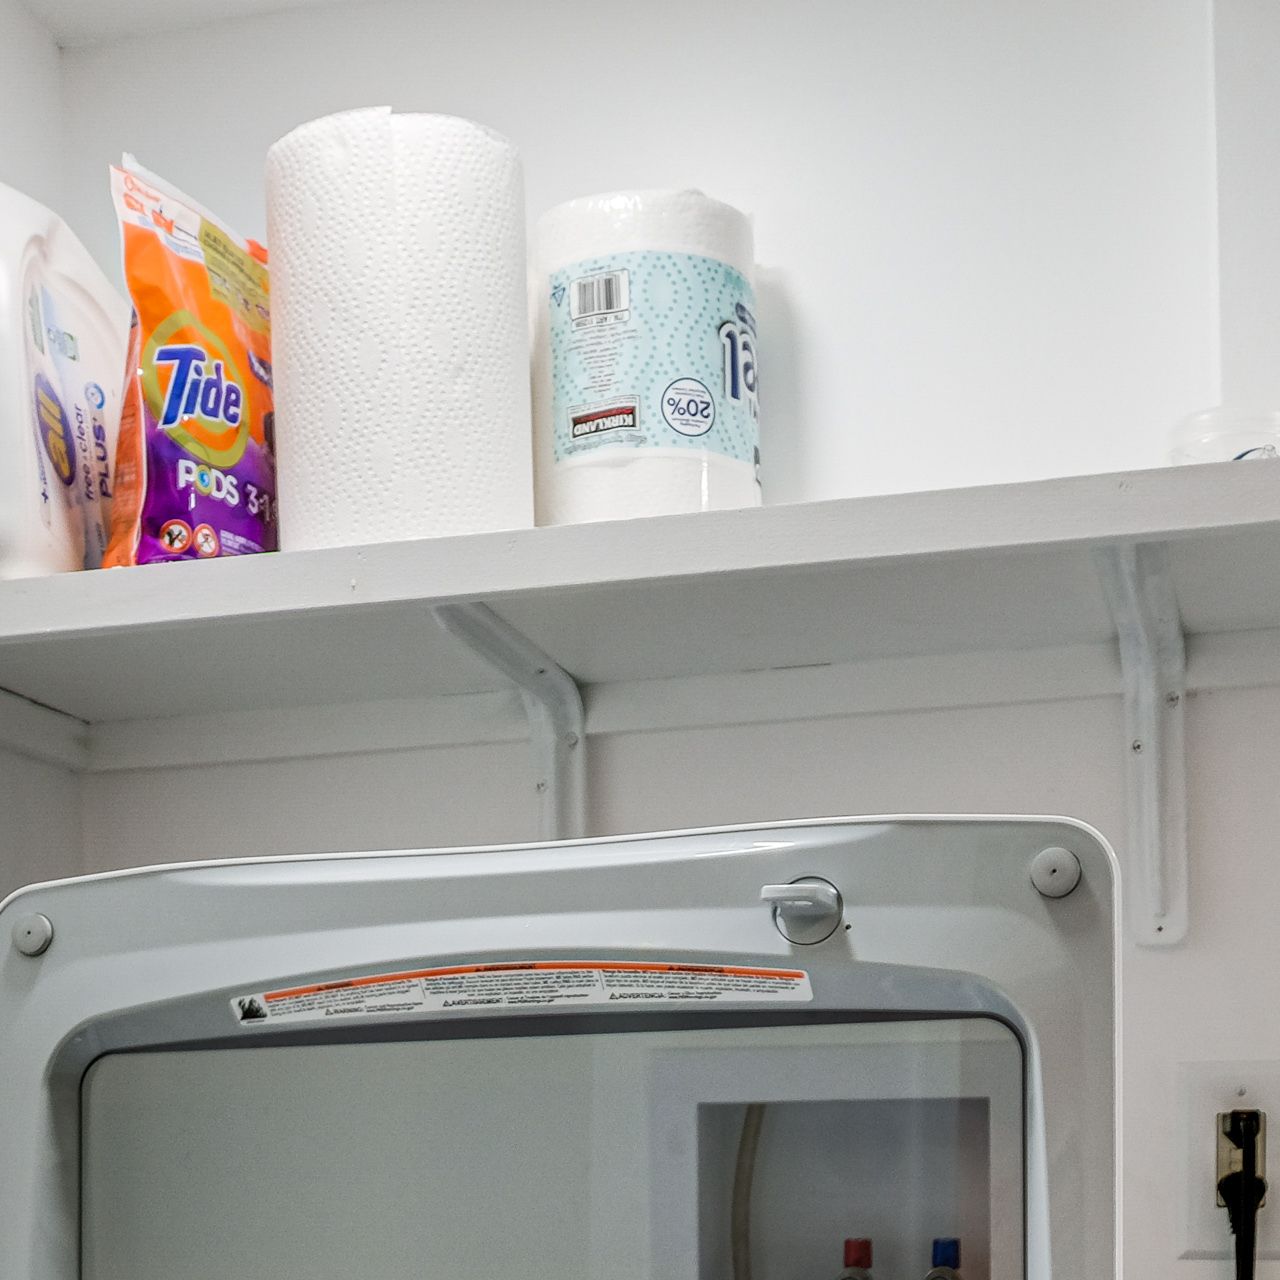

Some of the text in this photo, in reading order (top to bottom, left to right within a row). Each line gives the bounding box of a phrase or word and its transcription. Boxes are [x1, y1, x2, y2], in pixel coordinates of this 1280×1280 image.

[154, 346, 243, 428] Tide
[573, 414, 634, 435] KIRKLAND
[666, 397, 711, 419] 20%
[74, 403, 88, 453] clear
[82, 464, 95, 501] free
